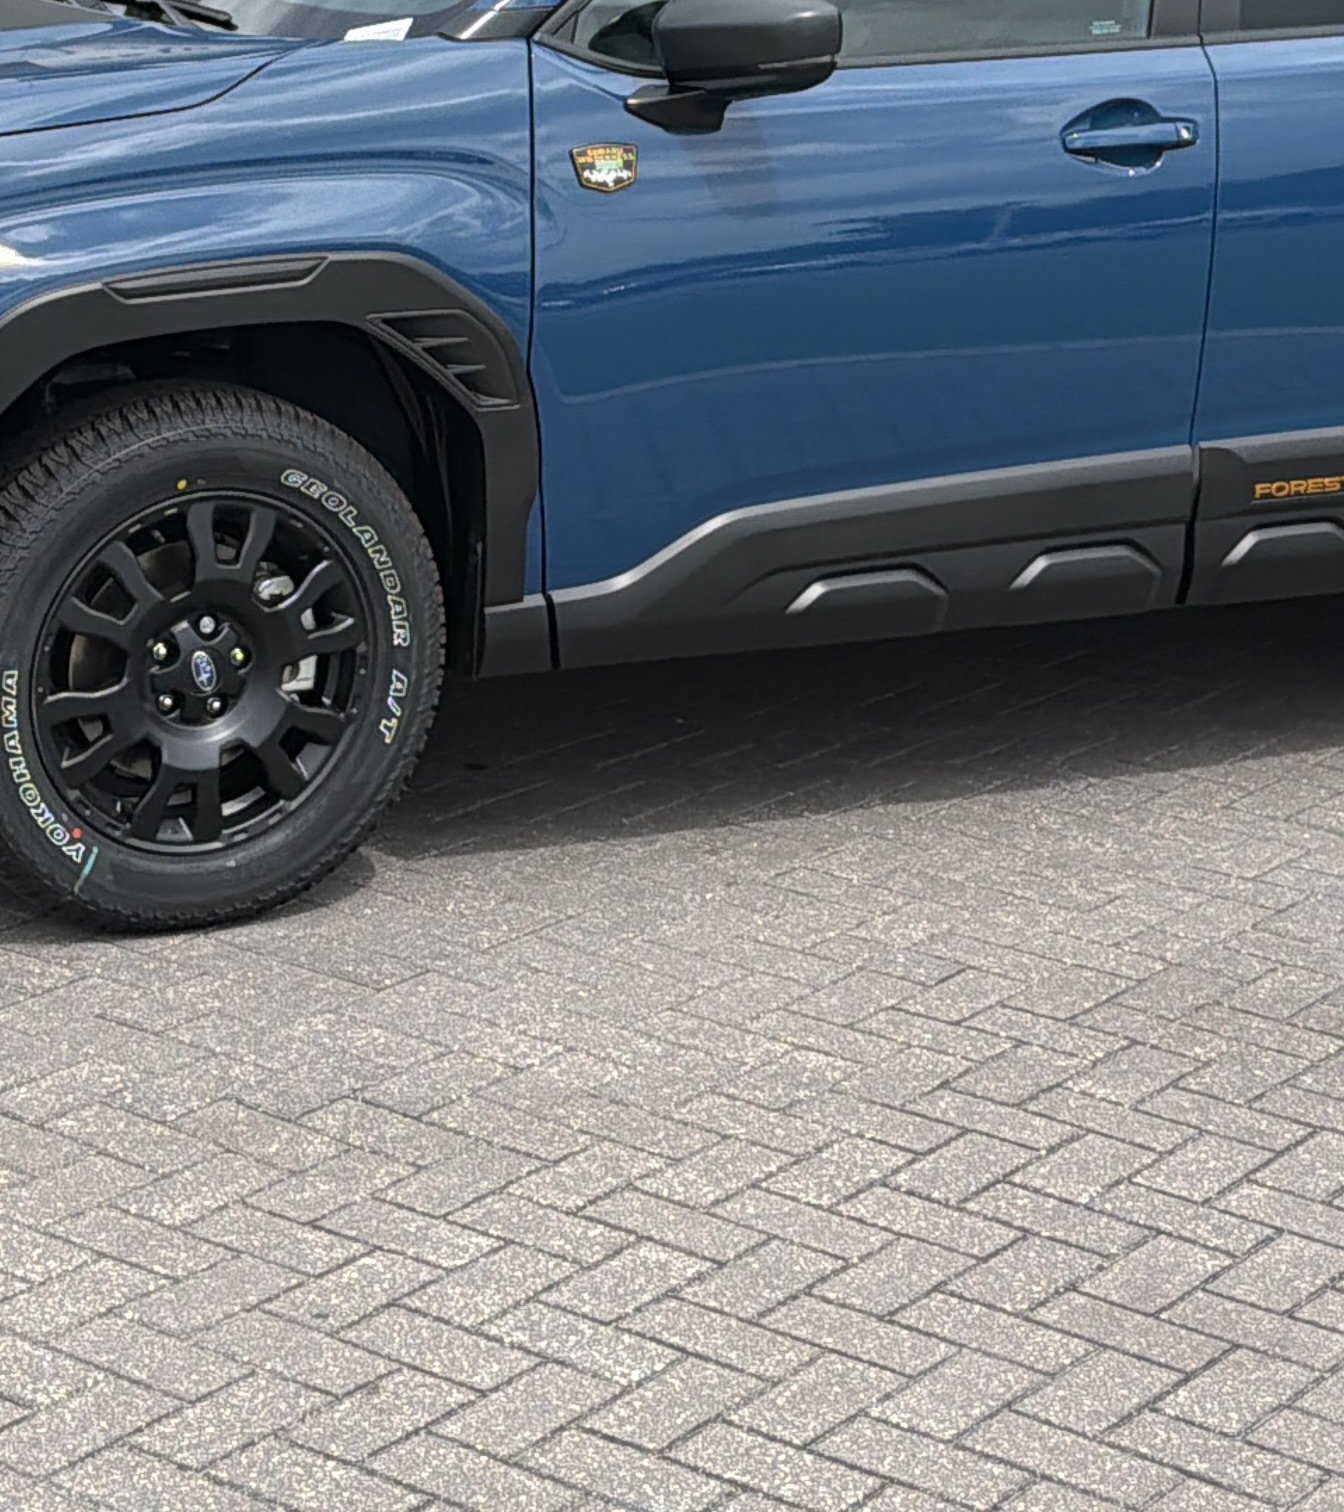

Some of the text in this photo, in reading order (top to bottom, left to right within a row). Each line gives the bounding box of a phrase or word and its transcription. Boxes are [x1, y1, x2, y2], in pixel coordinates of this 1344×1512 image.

[281, 469, 410, 744] GEOLANDAR A/T
[1, 670, 86, 864] YOKOHAMA
